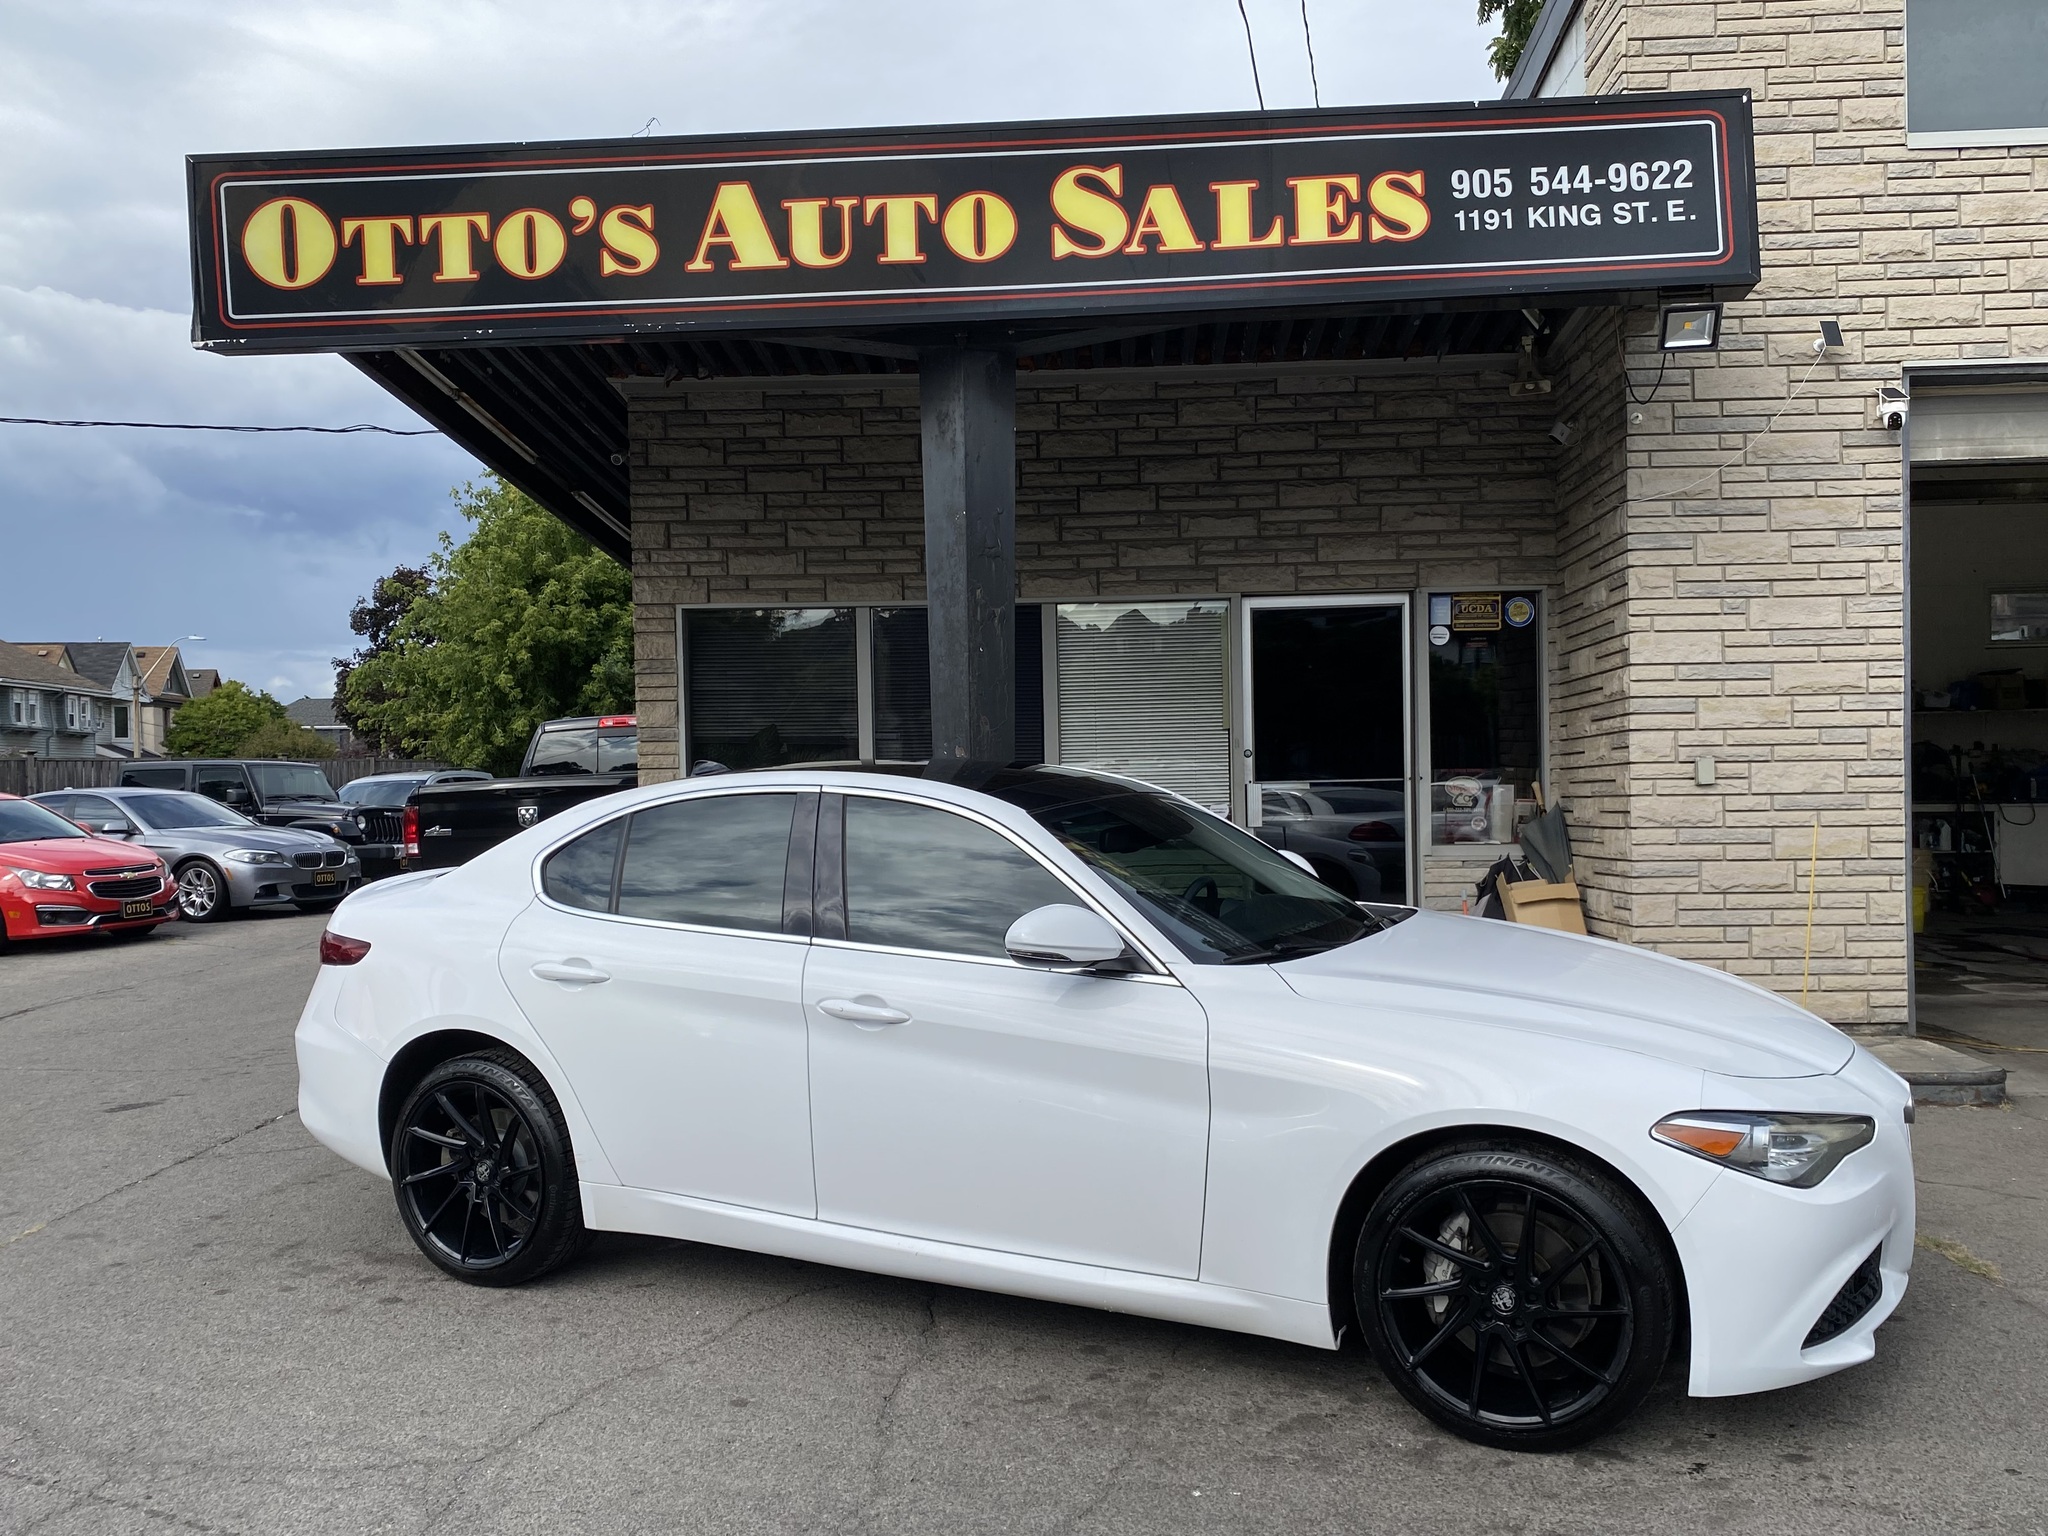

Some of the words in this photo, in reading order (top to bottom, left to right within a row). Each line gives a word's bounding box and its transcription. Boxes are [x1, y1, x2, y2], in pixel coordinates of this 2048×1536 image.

[1450, 168, 1513, 199] 905
[1530, 159, 1693, 197] 544-9622
[1454, 208, 1513, 231] 1191
[1527, 204, 1601, 229] KING
[1612, 201, 1657, 225] ST.
[1666, 199, 1696, 222] E.
[241, 196, 660, 290] OTTO'S
[684, 180, 1019, 273] AUTO
[1049, 163, 1431, 260] SALES
[1461, 604, 1493, 613] UCDA
[315, 872, 335, 883] OTTOS
[126, 902, 151, 914] OTTOS
